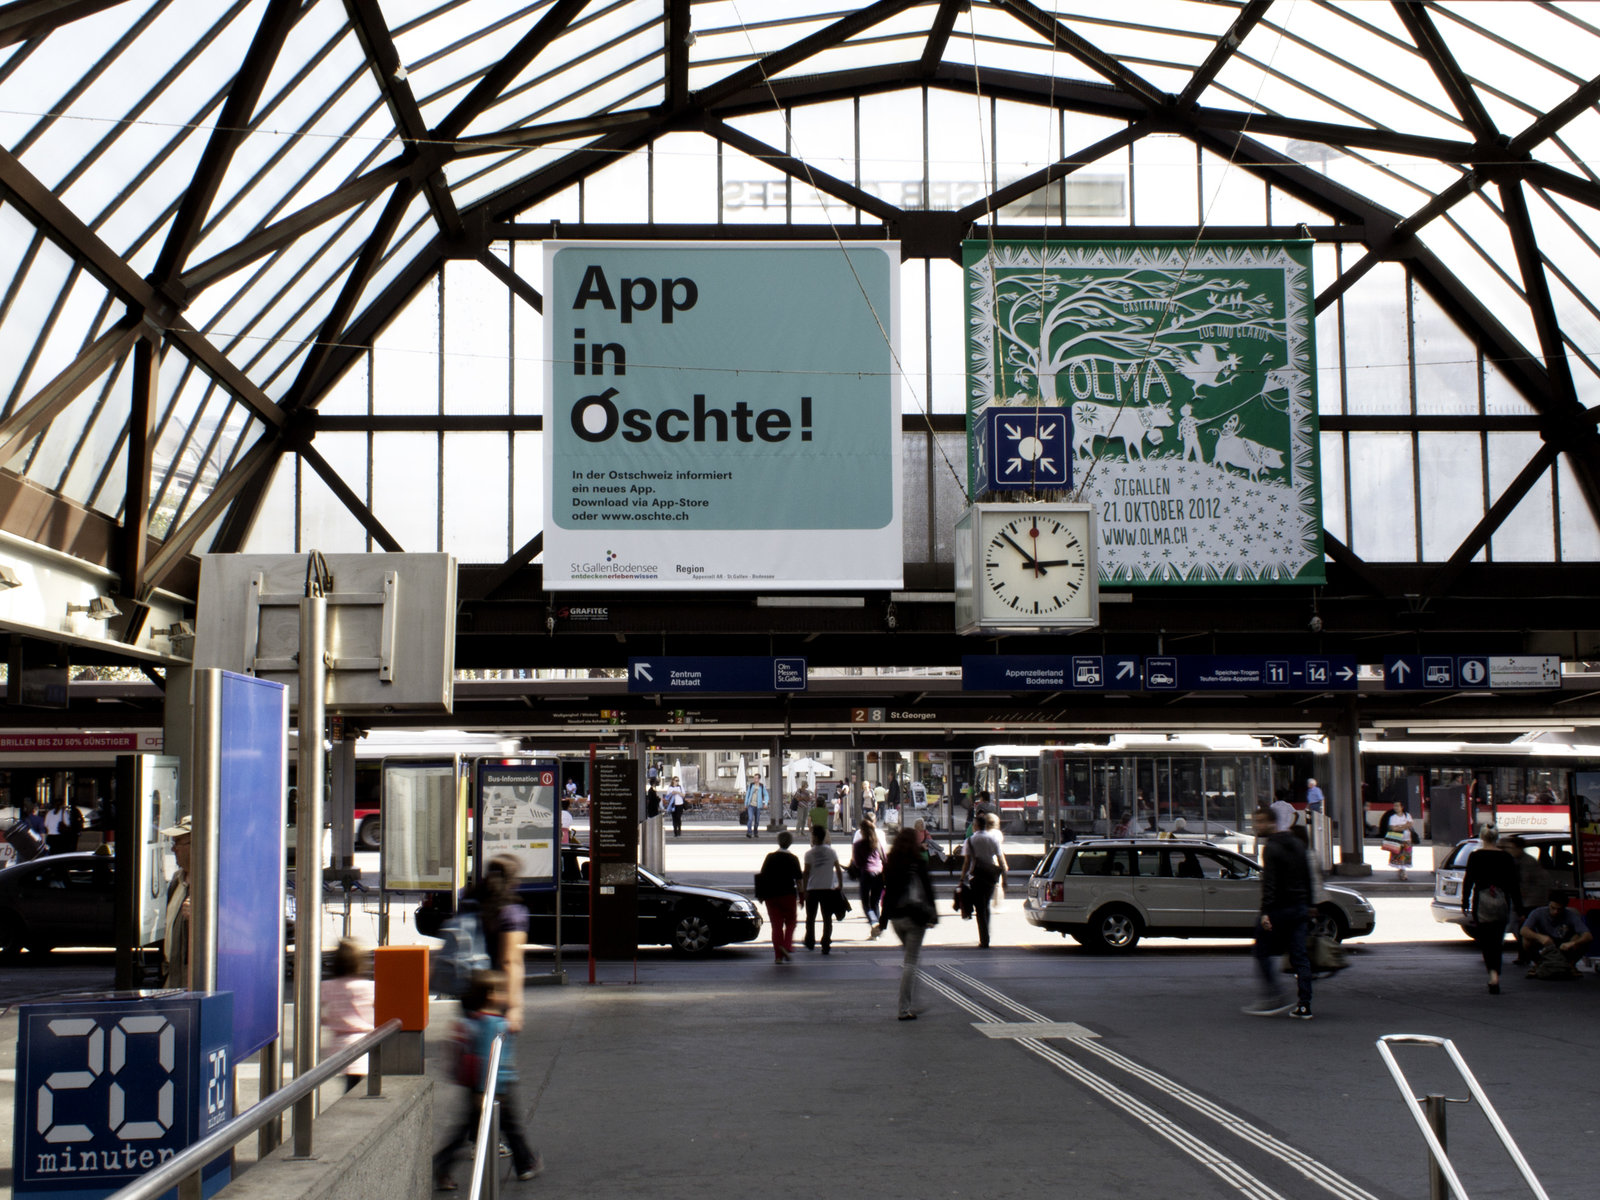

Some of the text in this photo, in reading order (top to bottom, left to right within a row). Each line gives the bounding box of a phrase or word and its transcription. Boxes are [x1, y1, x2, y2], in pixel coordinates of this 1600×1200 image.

[571, 264, 699, 324] App
[573, 327, 627, 376] in
[1069, 358, 1172, 402] OLMA
[572, 470, 733, 481] In der Ostschweiz informiert
[572, 484, 656, 496] ein neues App.
[1113, 477, 1171, 497] ST.GALLEN
[571, 498, 710, 510] Download via App-Store
[1103, 497, 1221, 523] 21. OKTOBER 2012
[571, 511, 689, 521] oder www.oschte.ch
[1102, 526, 1188, 547] WWW.OLMA.CH
[675, 564, 705, 576] Region
[569, 607, 609, 615] GRAFITEC
[669, 670, 702, 678] Zentrum
[1005, 669, 1064, 679] Appenzellerland
[1270, 667, 1284, 682] 11
[1308, 667, 1327, 682] 14
[670, 678, 701, 686] Altstadt
[1026, 677, 1064, 685] Bodensee
[855, 710, 937, 721] 2 8 St.Georgen
[0, 738, 36, 747] BRILLEN
[37, 738, 51, 746] BIS
[52, 738, 63, 746] ZU
[83, 736, 130, 746] GÜNSTIGER
[487, 775, 539, 783] Bus-Information
[37, 1015, 176, 1144] 20
[208, 1049, 227, 1115] 20
